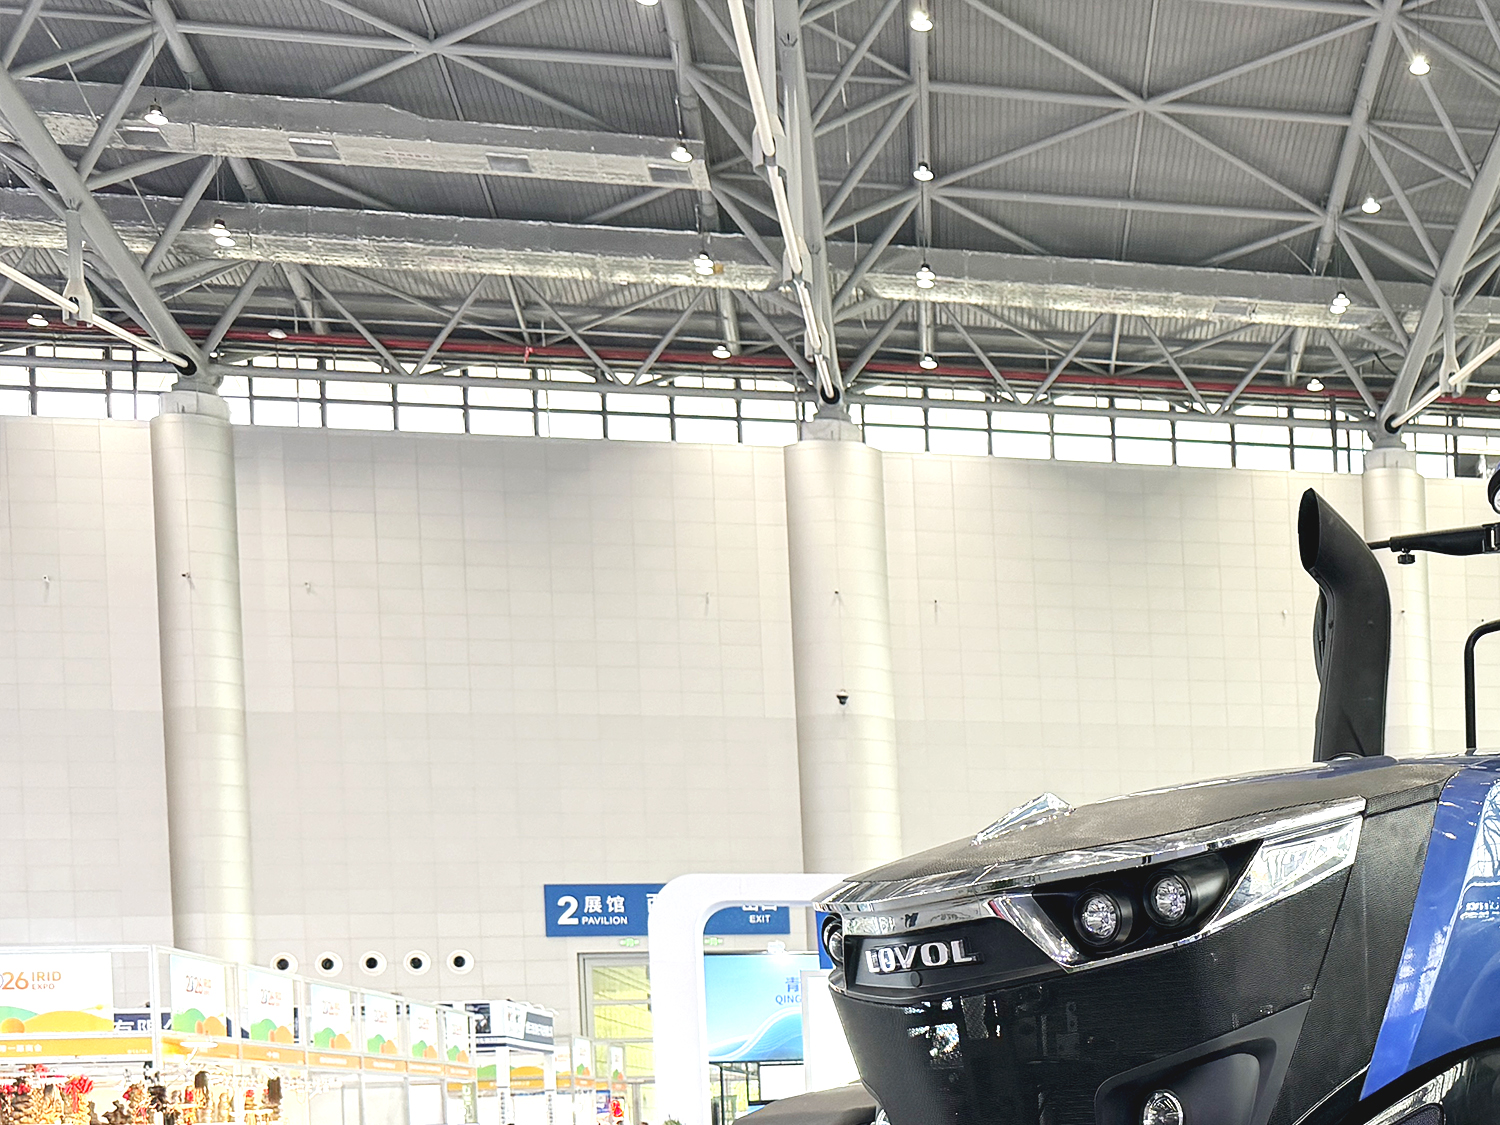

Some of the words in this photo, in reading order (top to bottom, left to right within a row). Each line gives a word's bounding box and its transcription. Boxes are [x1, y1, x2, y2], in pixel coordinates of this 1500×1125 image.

[557, 895, 579, 925] 2
[583, 895, 626, 913] 展馆
[582, 915, 628, 925] PAVILION
[749, 914, 771, 924] EXIT
[865, 938, 983, 974] LOVOL
[31, 971, 62, 982] IRID
[785, 976, 801, 993] 青
